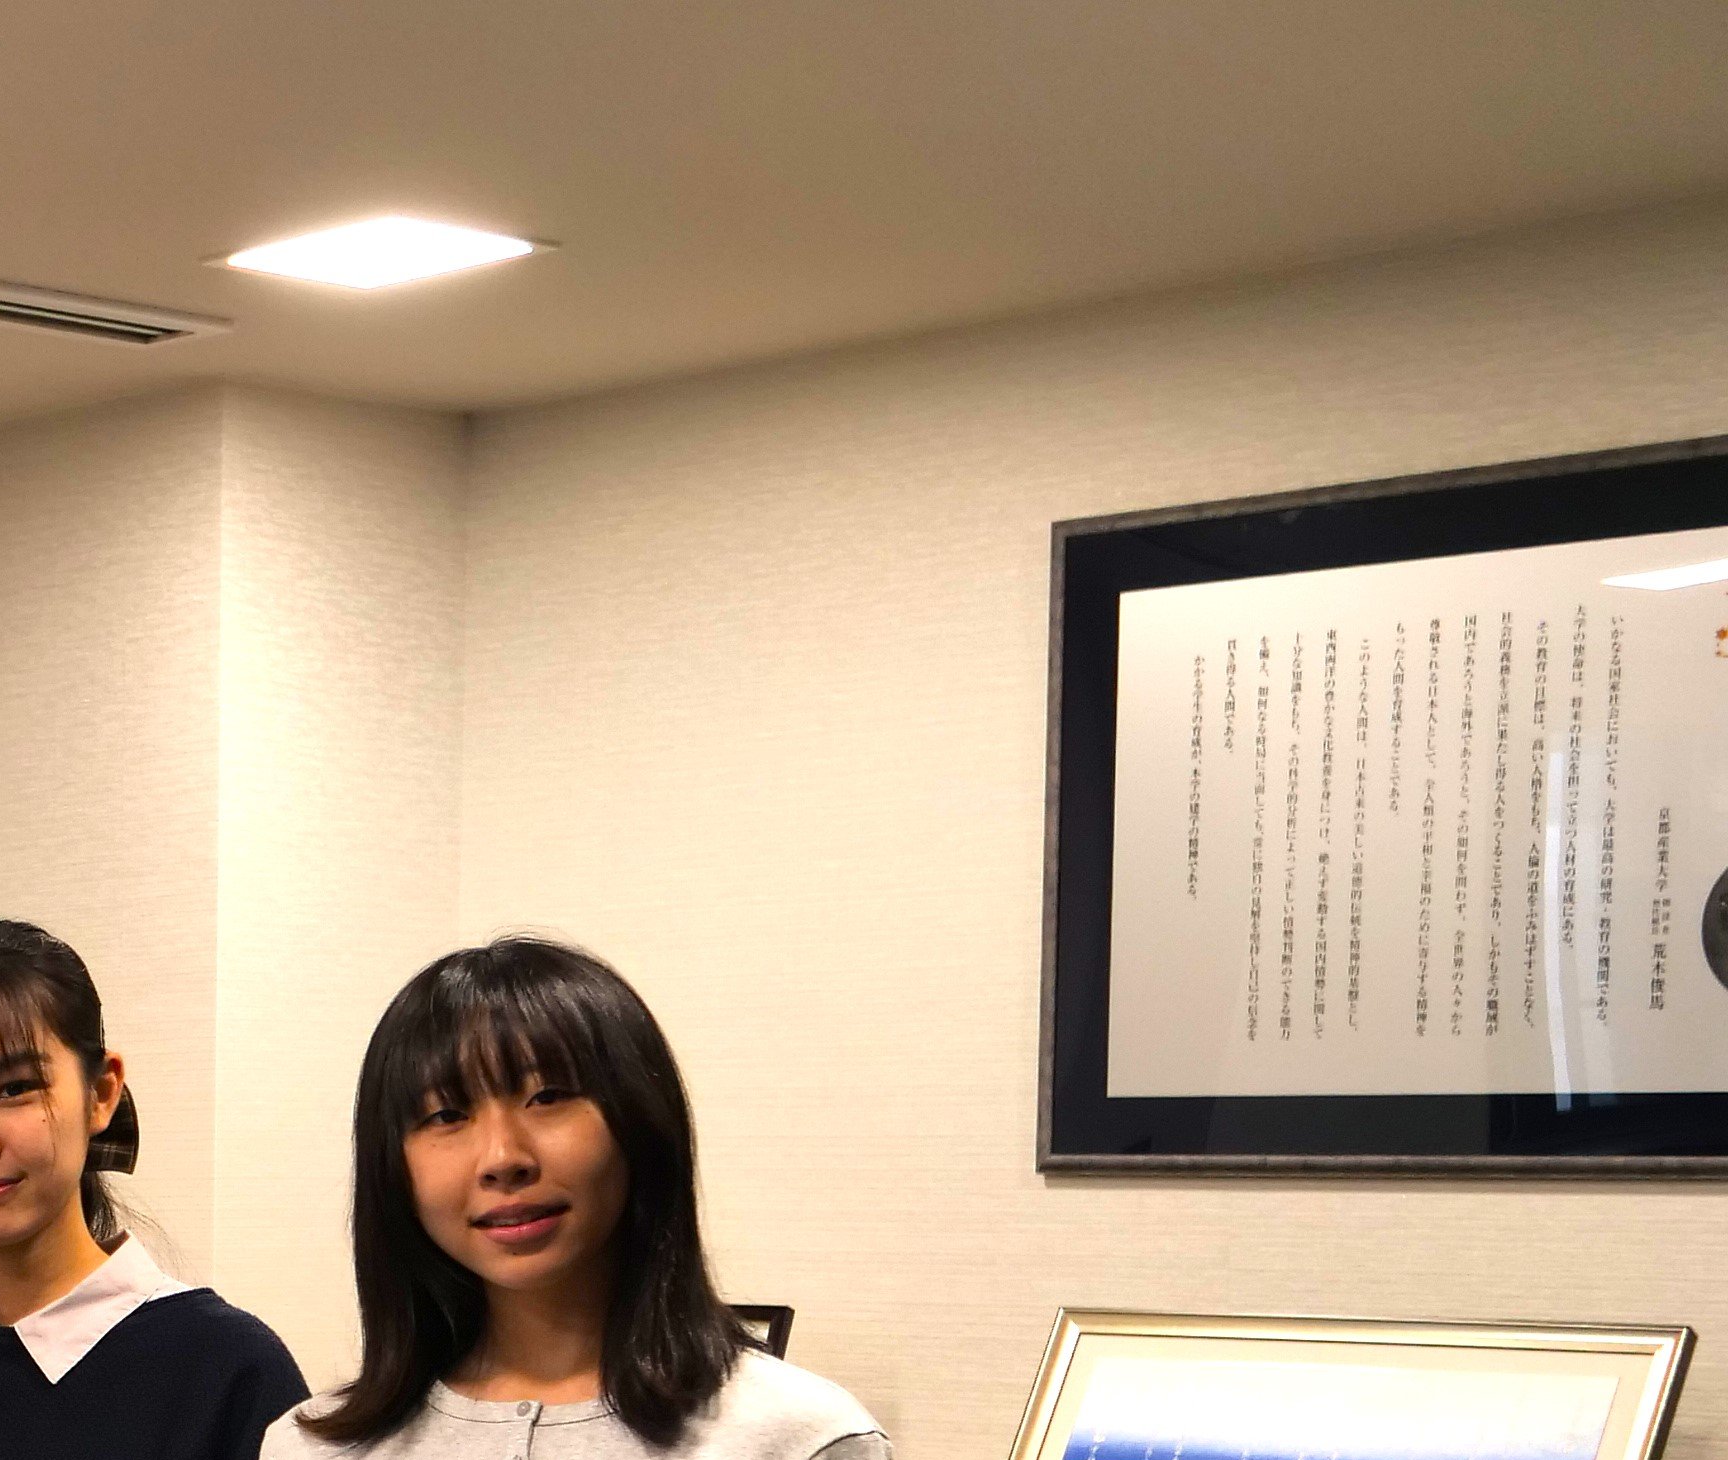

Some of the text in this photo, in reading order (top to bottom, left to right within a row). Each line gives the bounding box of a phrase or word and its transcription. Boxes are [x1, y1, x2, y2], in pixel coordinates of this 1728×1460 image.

[1654, 807, 1672, 893] 京都産業大学
